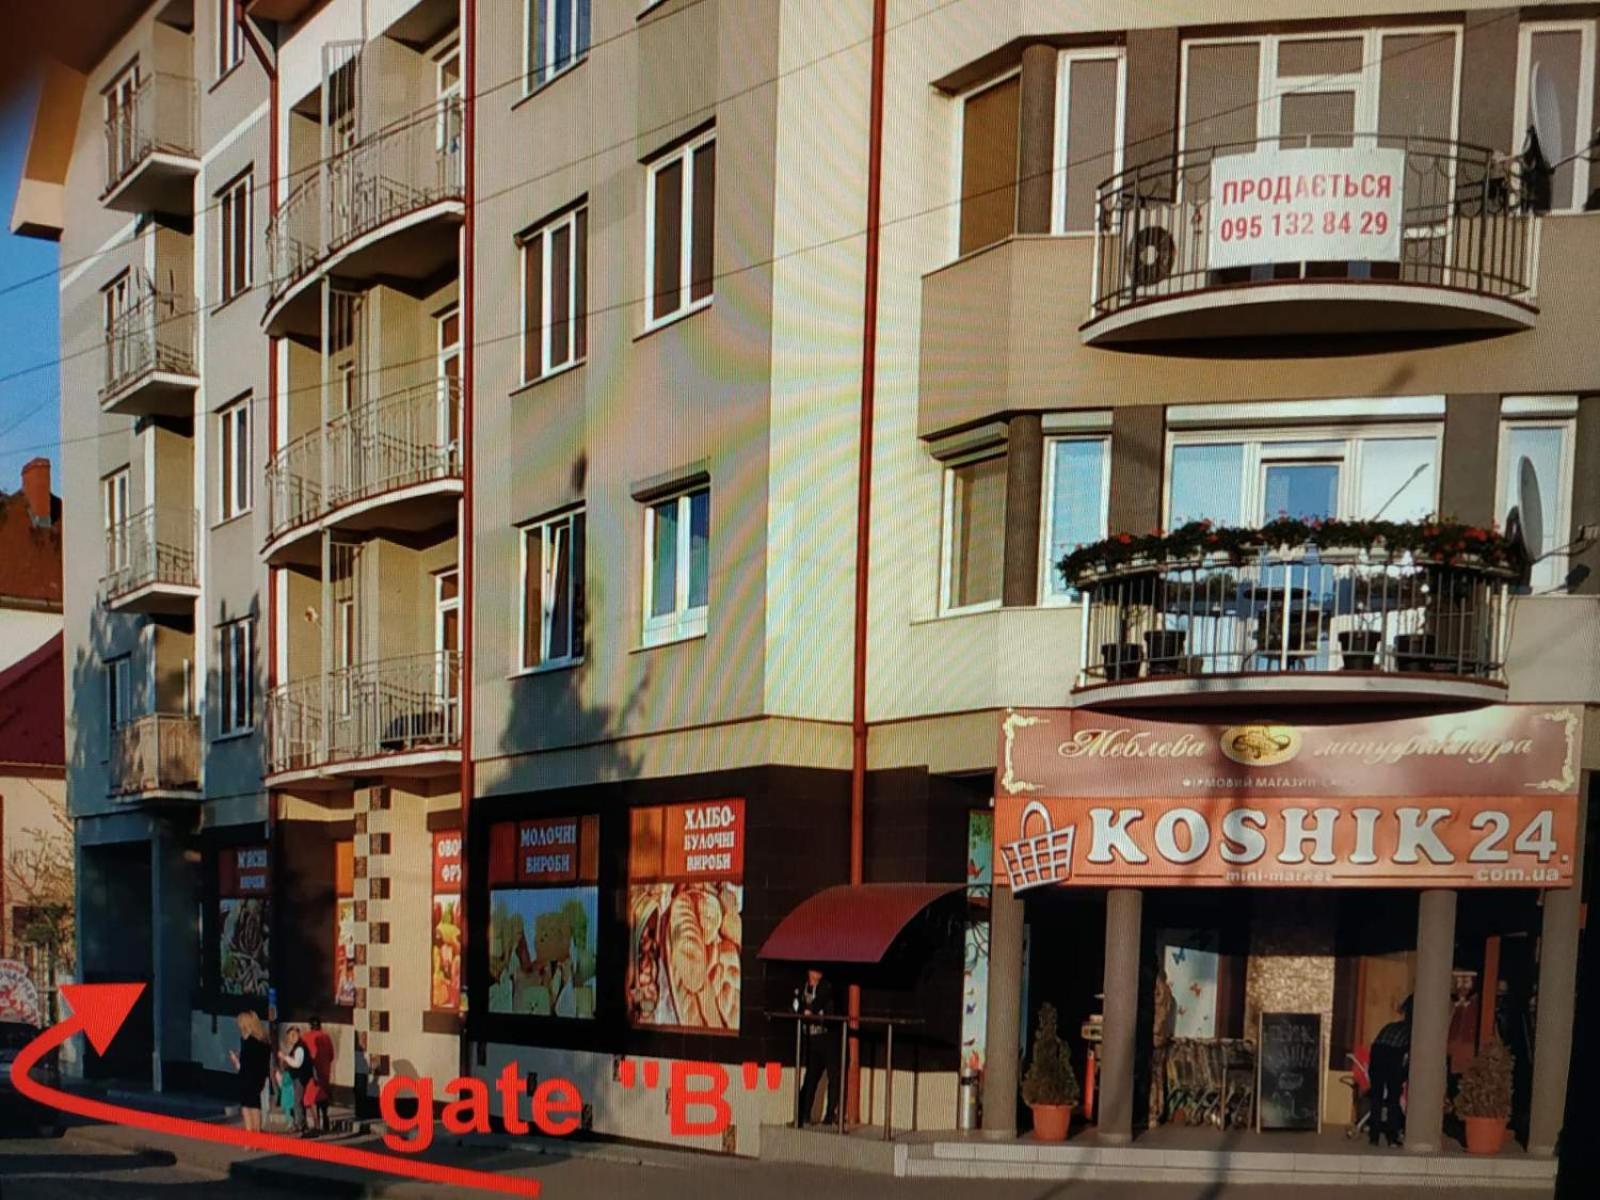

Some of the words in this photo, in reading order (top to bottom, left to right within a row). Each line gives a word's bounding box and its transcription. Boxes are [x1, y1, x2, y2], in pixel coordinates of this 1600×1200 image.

[1222, 173, 1392, 205] ПРОДАЄТЬСЯ
[1220, 215, 1262, 242] 095
[1272, 212, 1314, 236] 132
[1322, 211, 1351, 234] 84
[1360, 211, 1388, 235] 29
[520, 824, 577, 847] МОЛОЧНІ
[684, 830, 735, 851] БУЛОЧНІ
[1086, 807, 1456, 864] KOSHIK
[526, 854, 570, 873] ВИРОБИ
[686, 852, 732, 872] ВИРОБИ
[1476, 868, 1559, 882] com.ua
